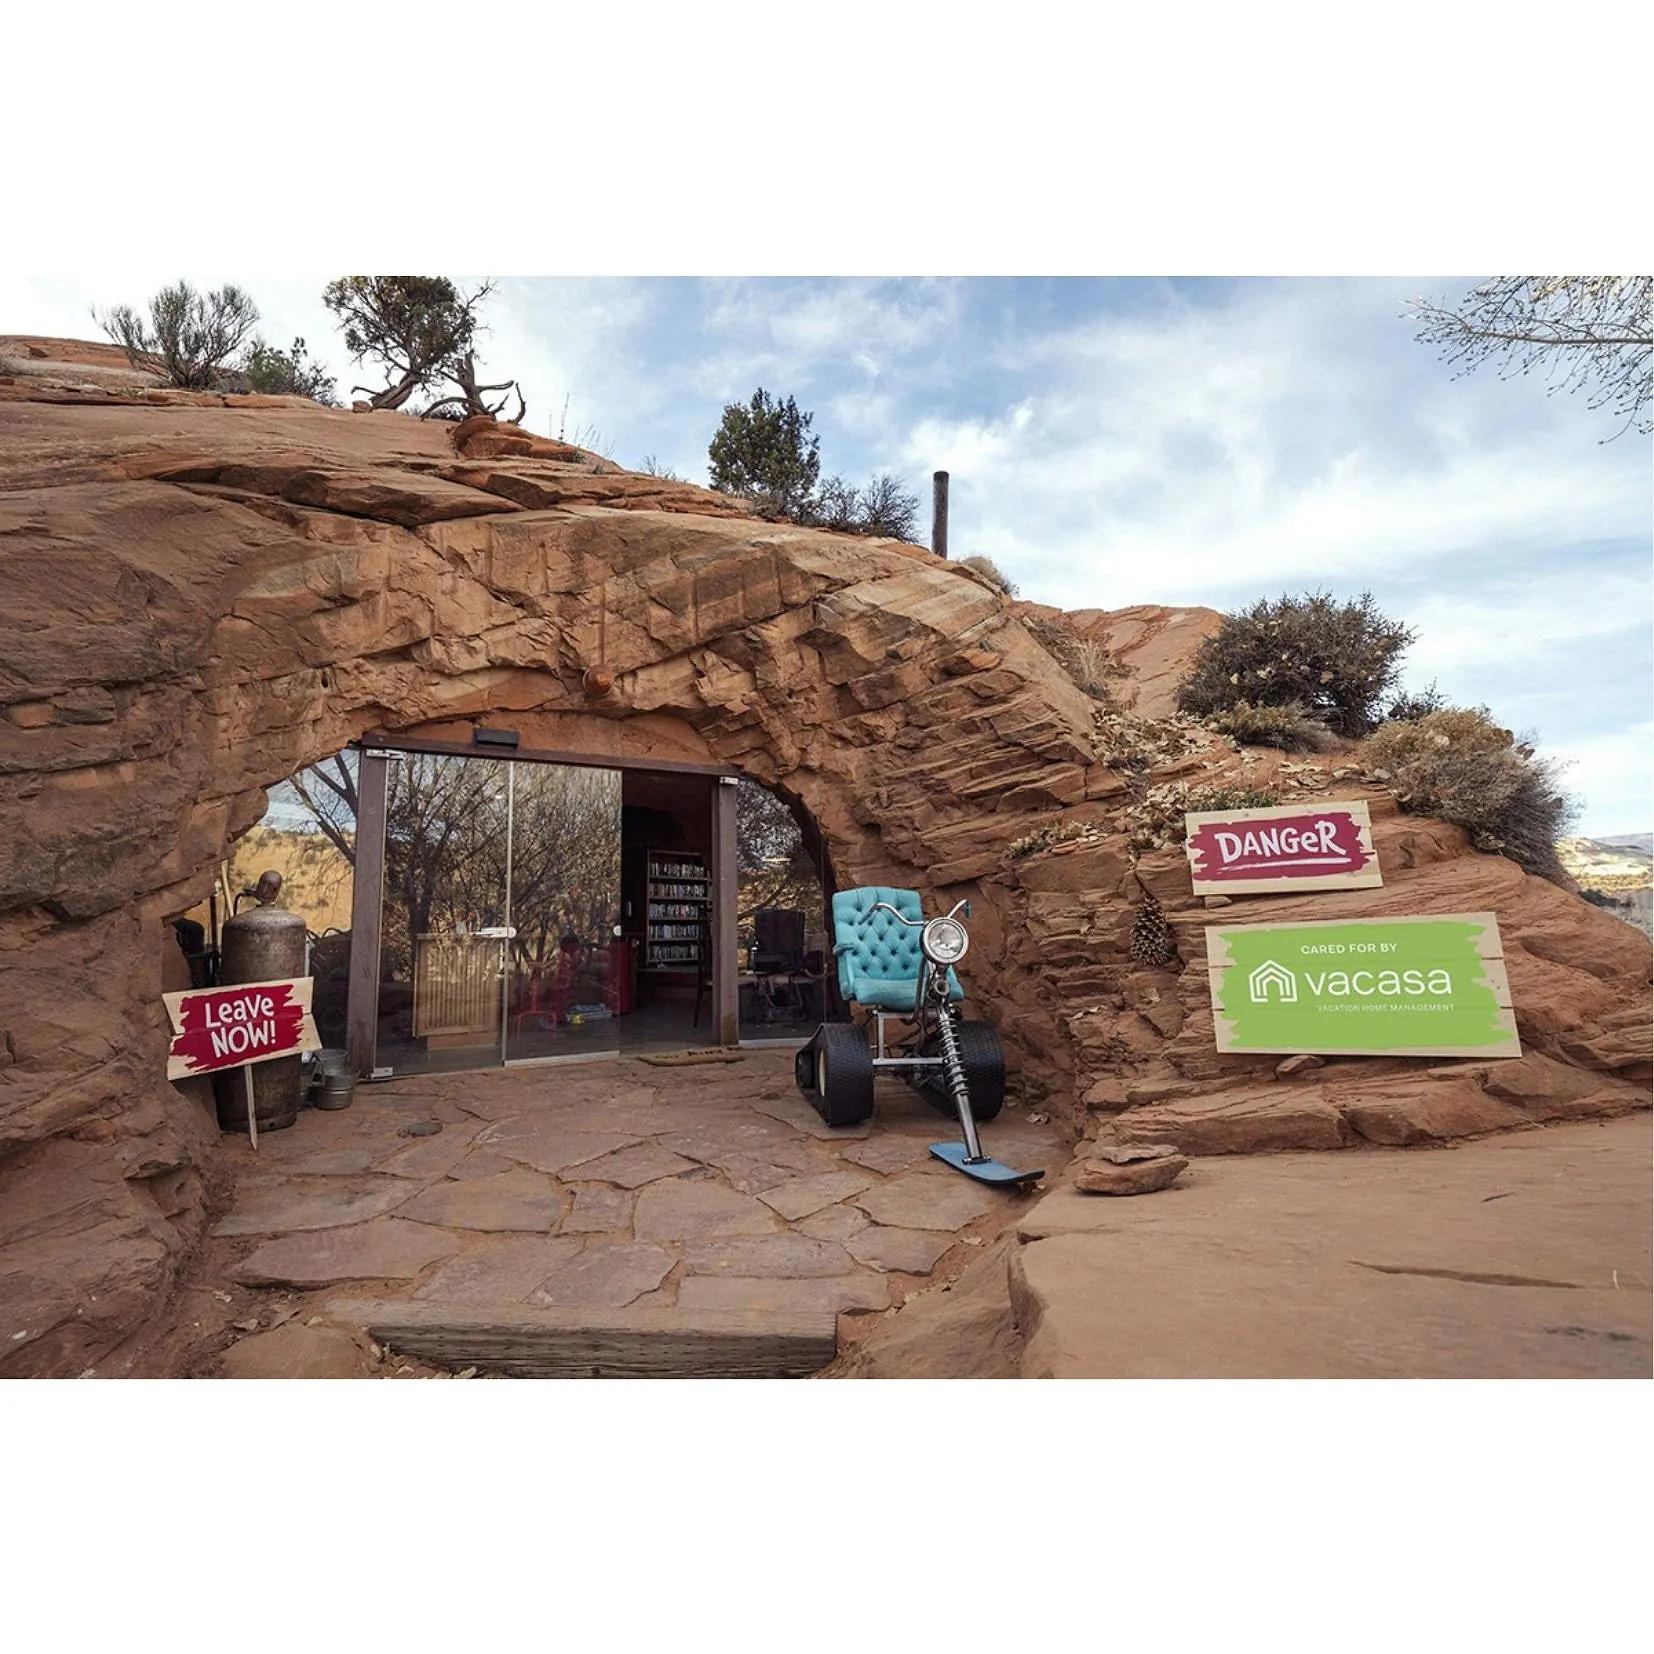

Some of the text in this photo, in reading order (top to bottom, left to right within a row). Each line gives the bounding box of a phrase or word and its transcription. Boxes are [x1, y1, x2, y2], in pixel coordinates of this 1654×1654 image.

[1300, 942, 1397, 955] CARED FOR BY
[1304, 969, 1453, 996] vacasa
[1317, 1003, 1455, 1013] VACATION HOME MANAGEMENT
[211, 1020, 277, 1059] NOW!
